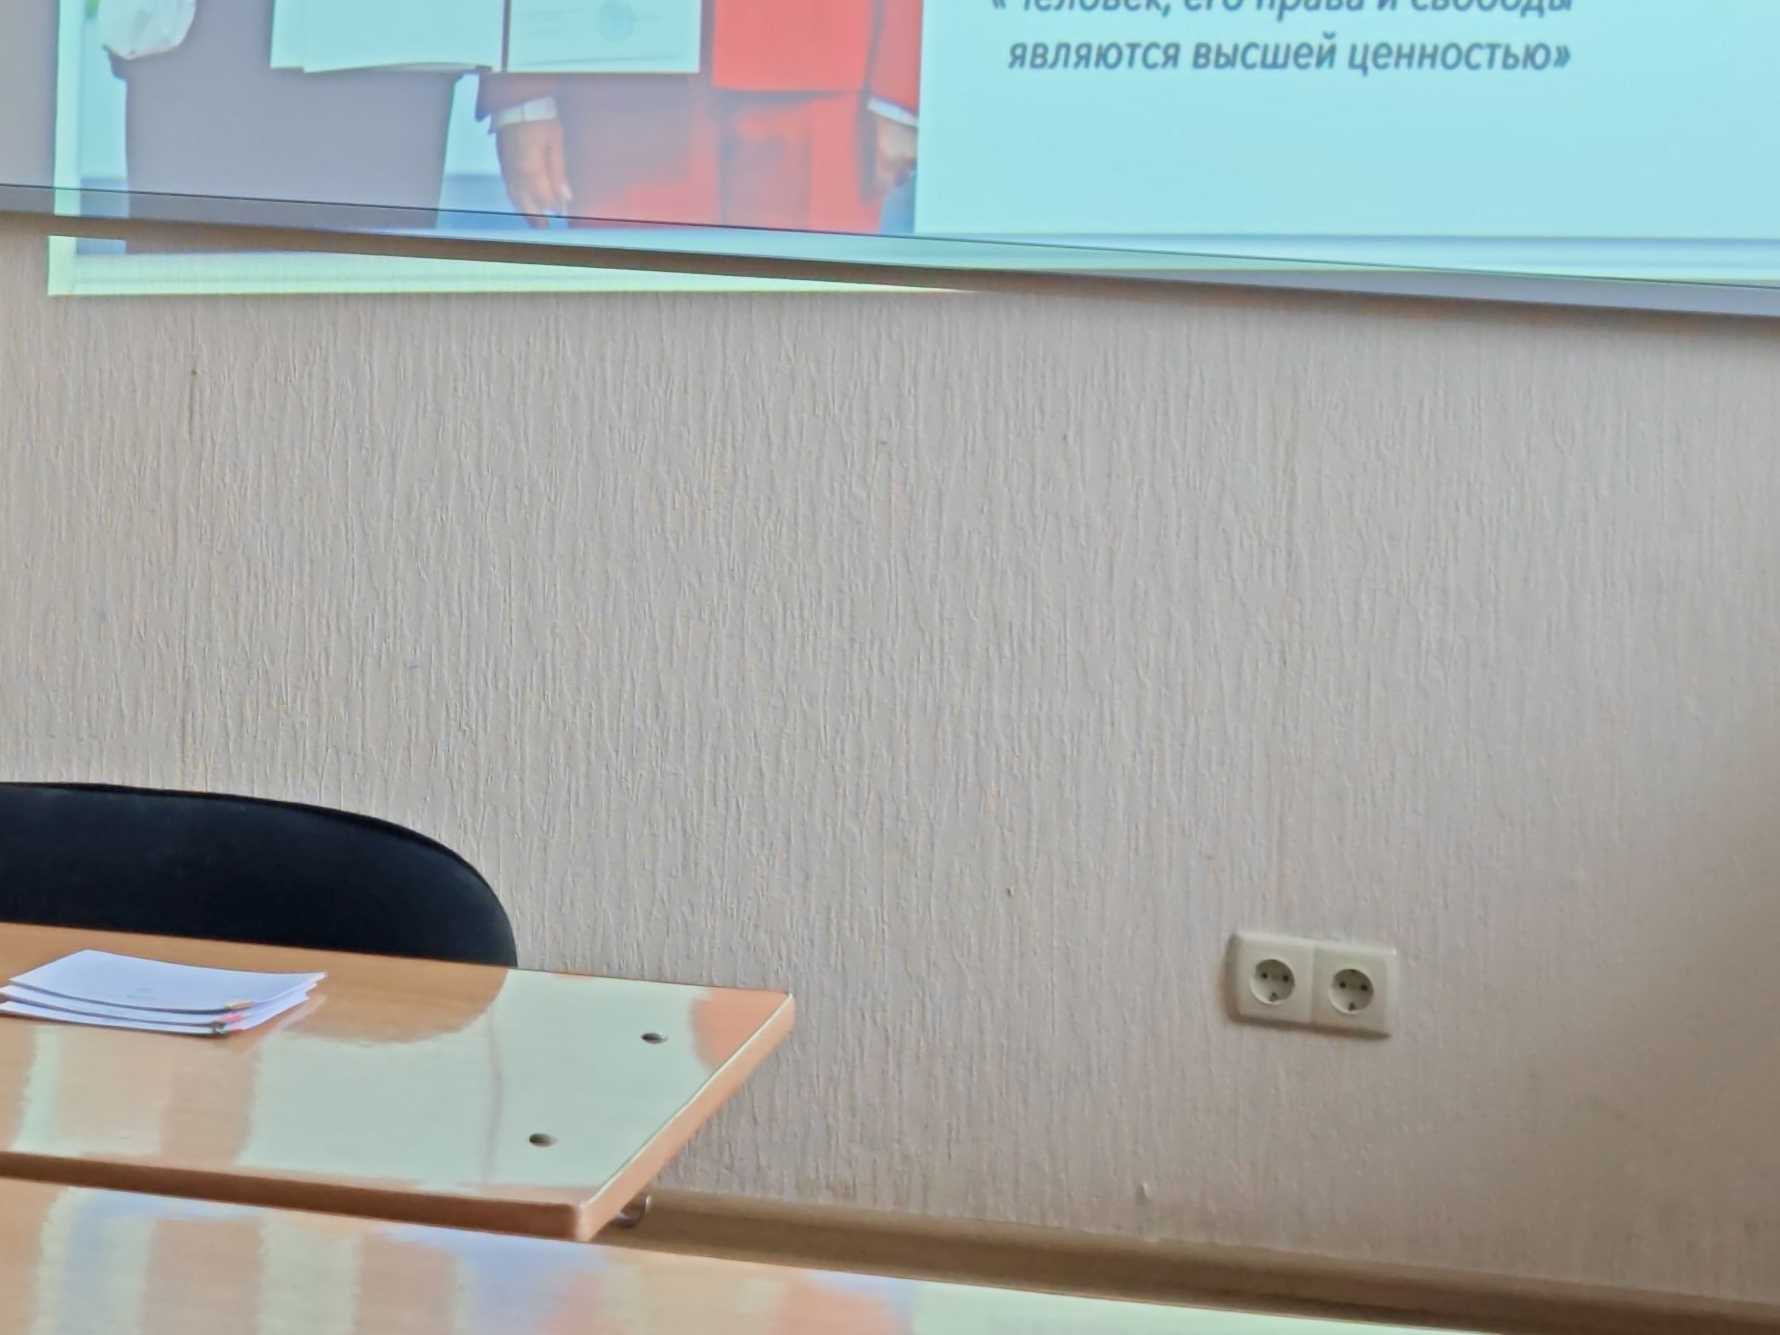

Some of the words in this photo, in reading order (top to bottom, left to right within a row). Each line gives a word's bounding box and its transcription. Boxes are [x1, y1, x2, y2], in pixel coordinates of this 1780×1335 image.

[1008, 41, 1180, 69] являются
[1192, 32, 1336, 69] высшей
[1347, 40, 1571, 76] ценностью»
